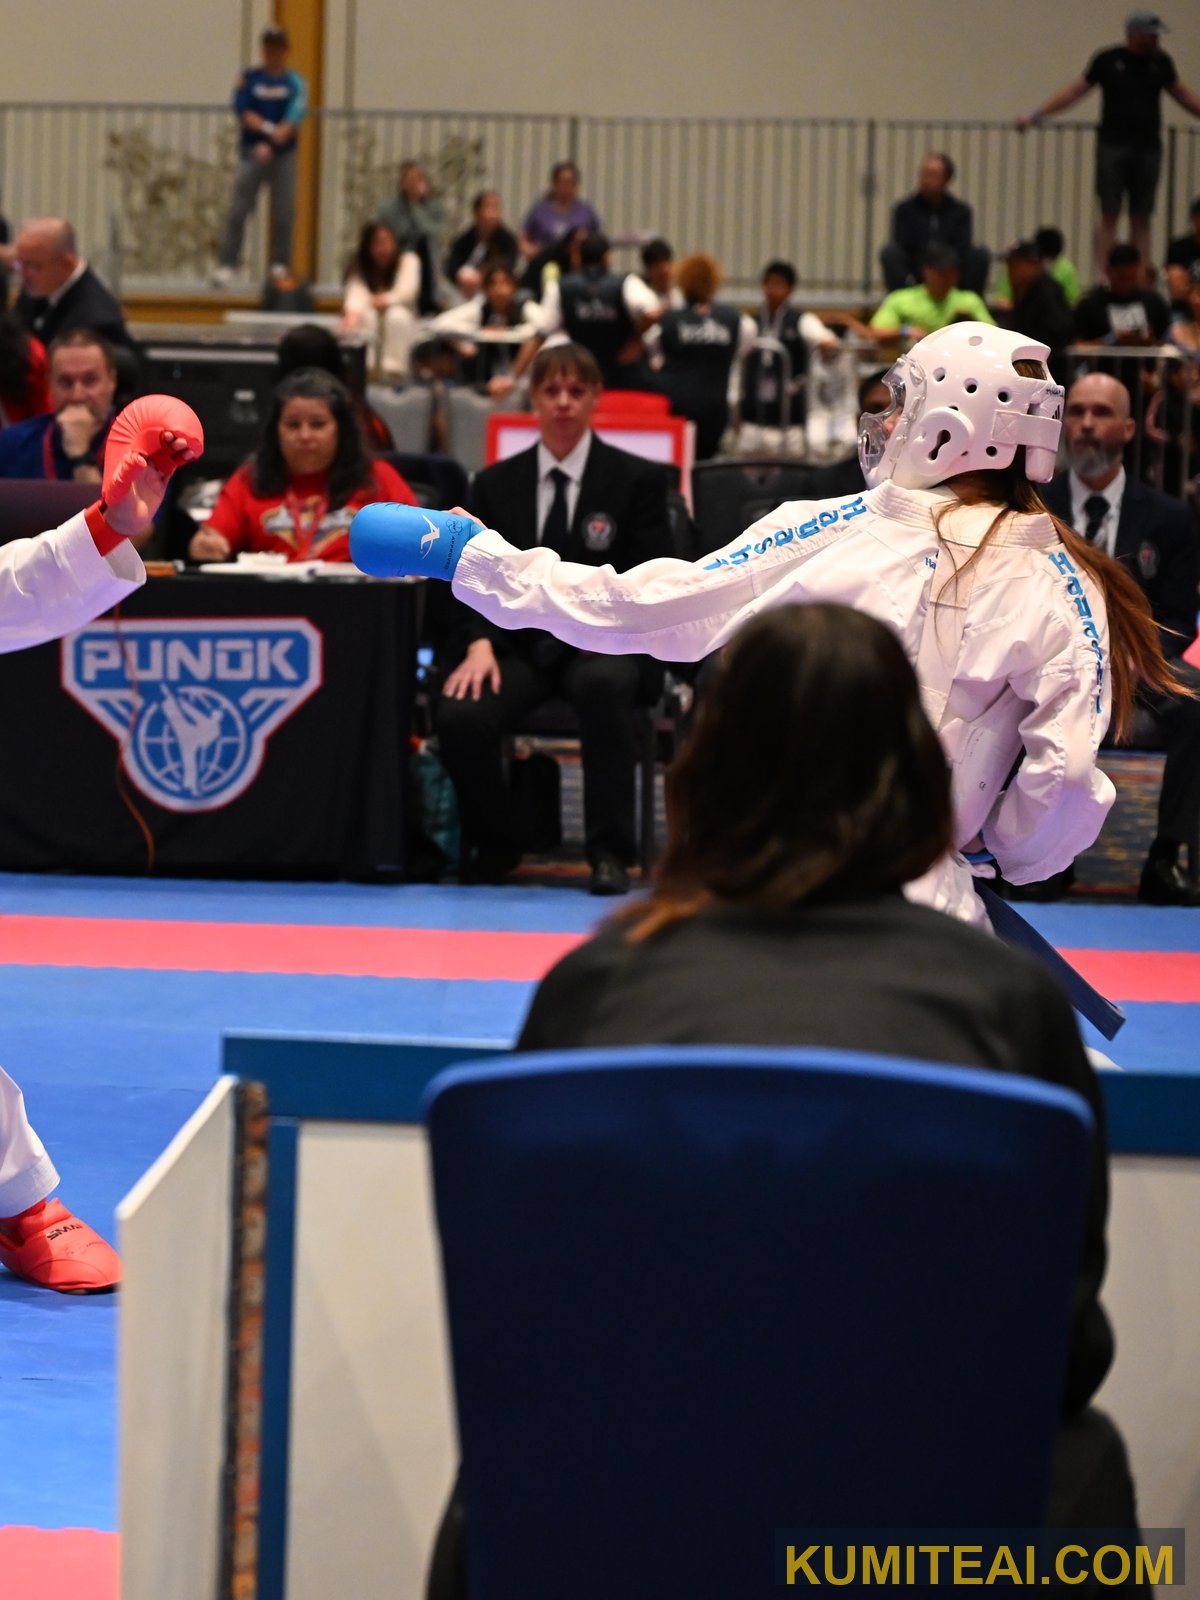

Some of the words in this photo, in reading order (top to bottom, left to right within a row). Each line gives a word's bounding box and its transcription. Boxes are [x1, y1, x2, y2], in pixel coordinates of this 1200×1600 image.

[444, 535, 455, 570] APPROVED
[703, 496, 868, 571] Hayashi
[82, 638, 299, 682] PUNOK
